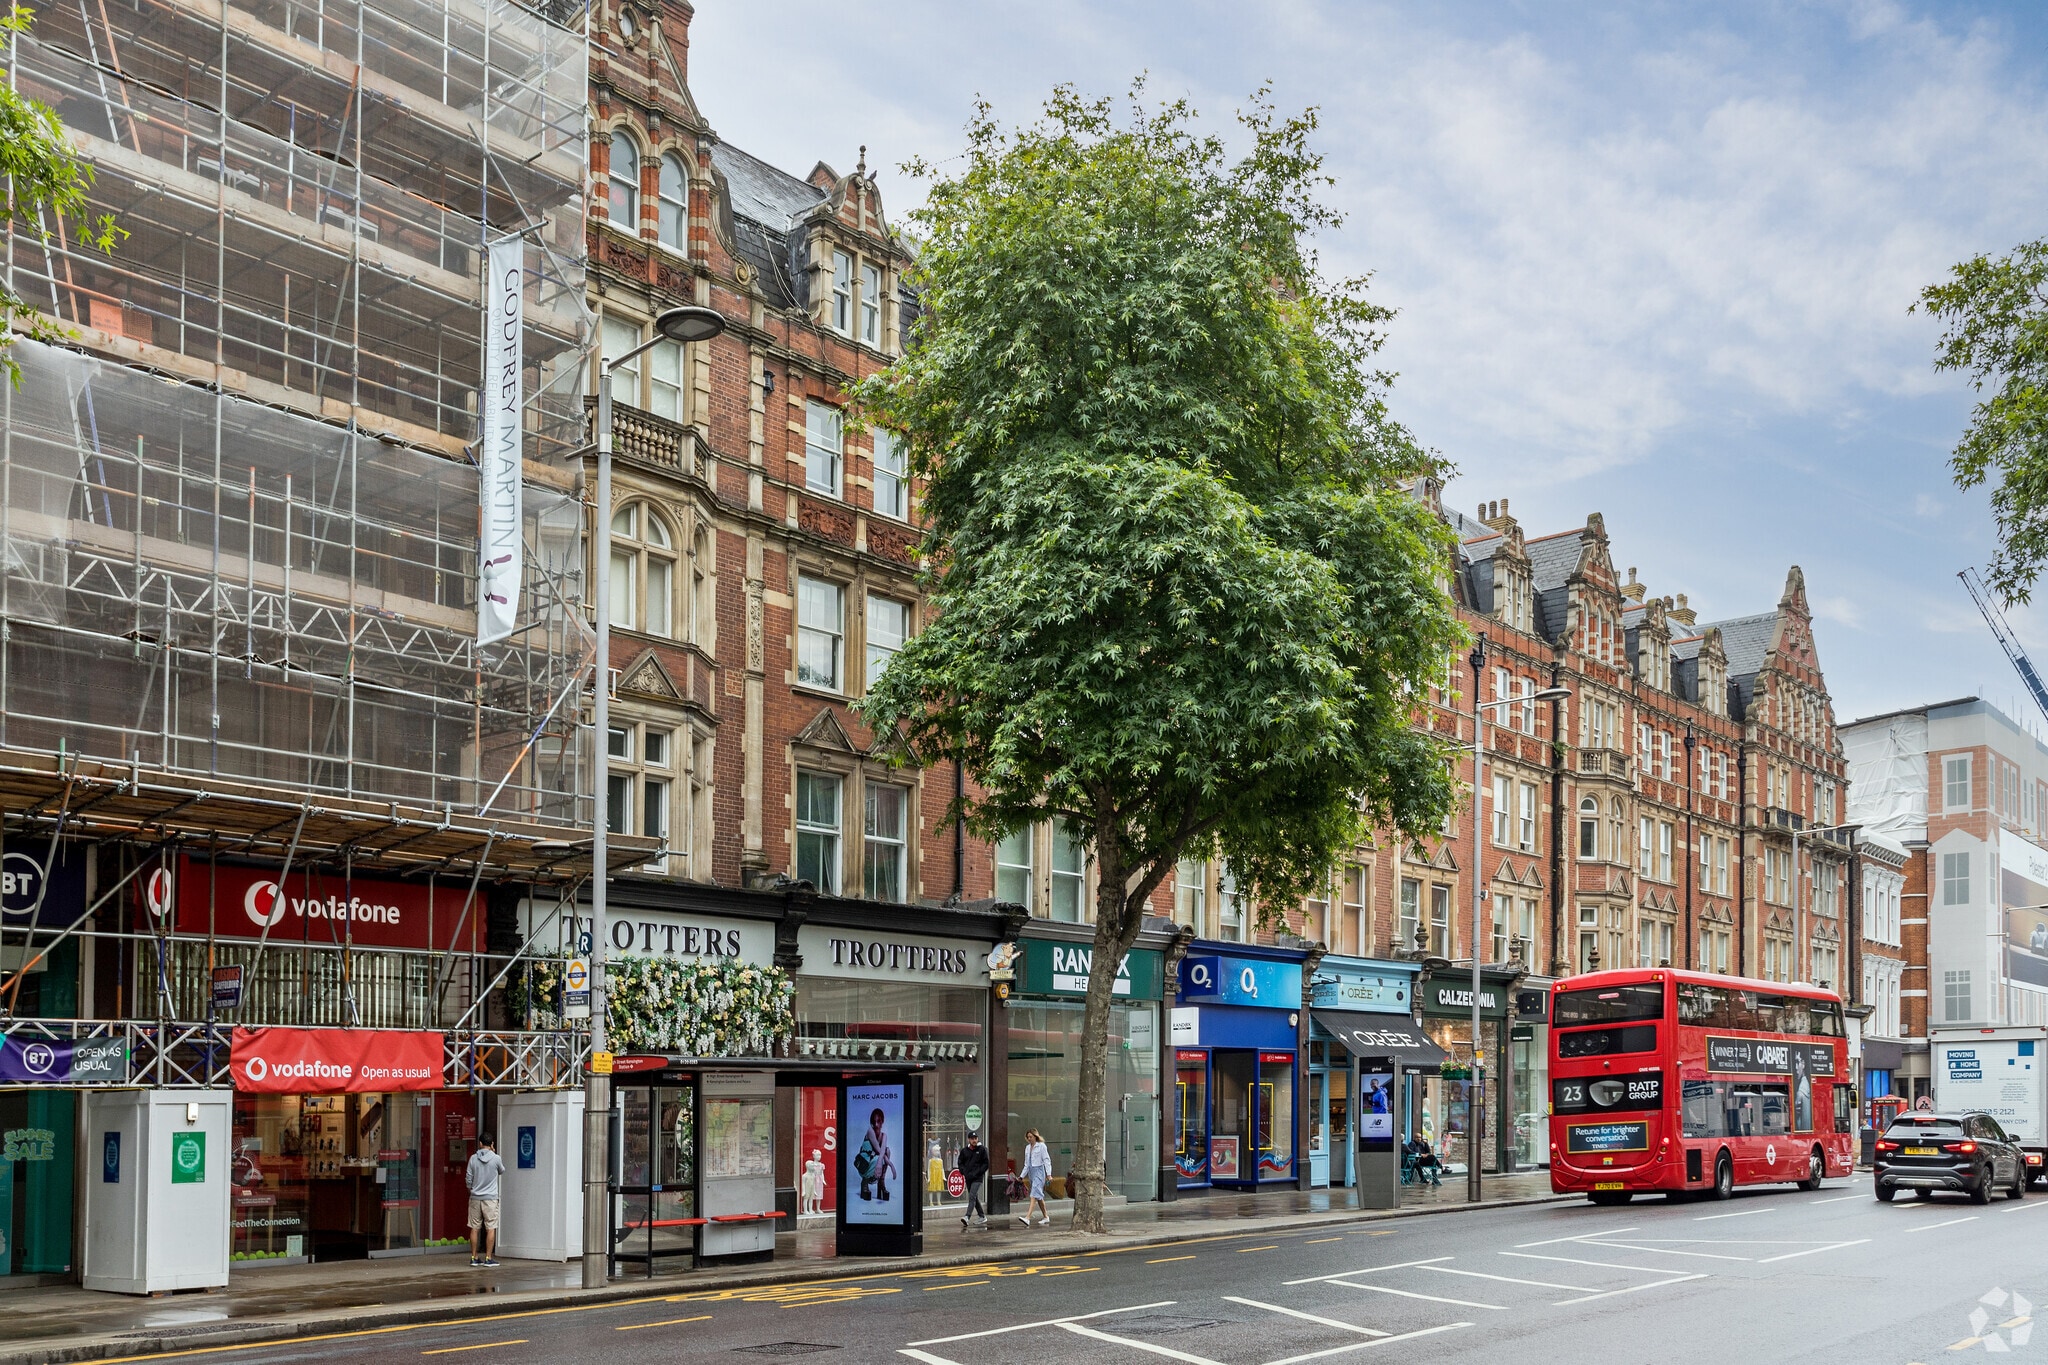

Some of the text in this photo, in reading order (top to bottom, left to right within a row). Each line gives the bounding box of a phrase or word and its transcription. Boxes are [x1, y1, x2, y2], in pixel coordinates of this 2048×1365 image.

[483, 307, 502, 514] QUALITY RELIABILITY DELIVERY
[491, 268, 519, 547] GODFREY MARTIN
[2, 872, 33, 895] BT
[291, 895, 400, 925] vodafone
[580, 935, 589, 952] R
[829, 938, 967, 974] TROTTERS
[1053, 946, 1131, 977] RANX
[29, 1052, 48, 1065] BT
[77, 1047, 122, 1059] OPEN AS
[1714, 1046, 1734, 1058] WINNER
[1756, 1045, 1789, 1065] CABARET
[74, 1061, 112, 1072] USUAL
[271, 1060, 431, 1080] vodafone Open as usual
[1628, 1081, 1659, 1092] RATP
[1563, 1086, 1582, 1102] 23
[1628, 1090, 1659, 1100] GROUP
[4, 1128, 55, 1141] SUMMER
[1575, 1125, 1640, 1136] Retune for brighter
[1585, 1134, 1629, 1143] conversation.
[4, 1140, 55, 1161] SALE
[950, 1176, 963, 1184] 60%
[950, 1184, 963, 1192] OFF
